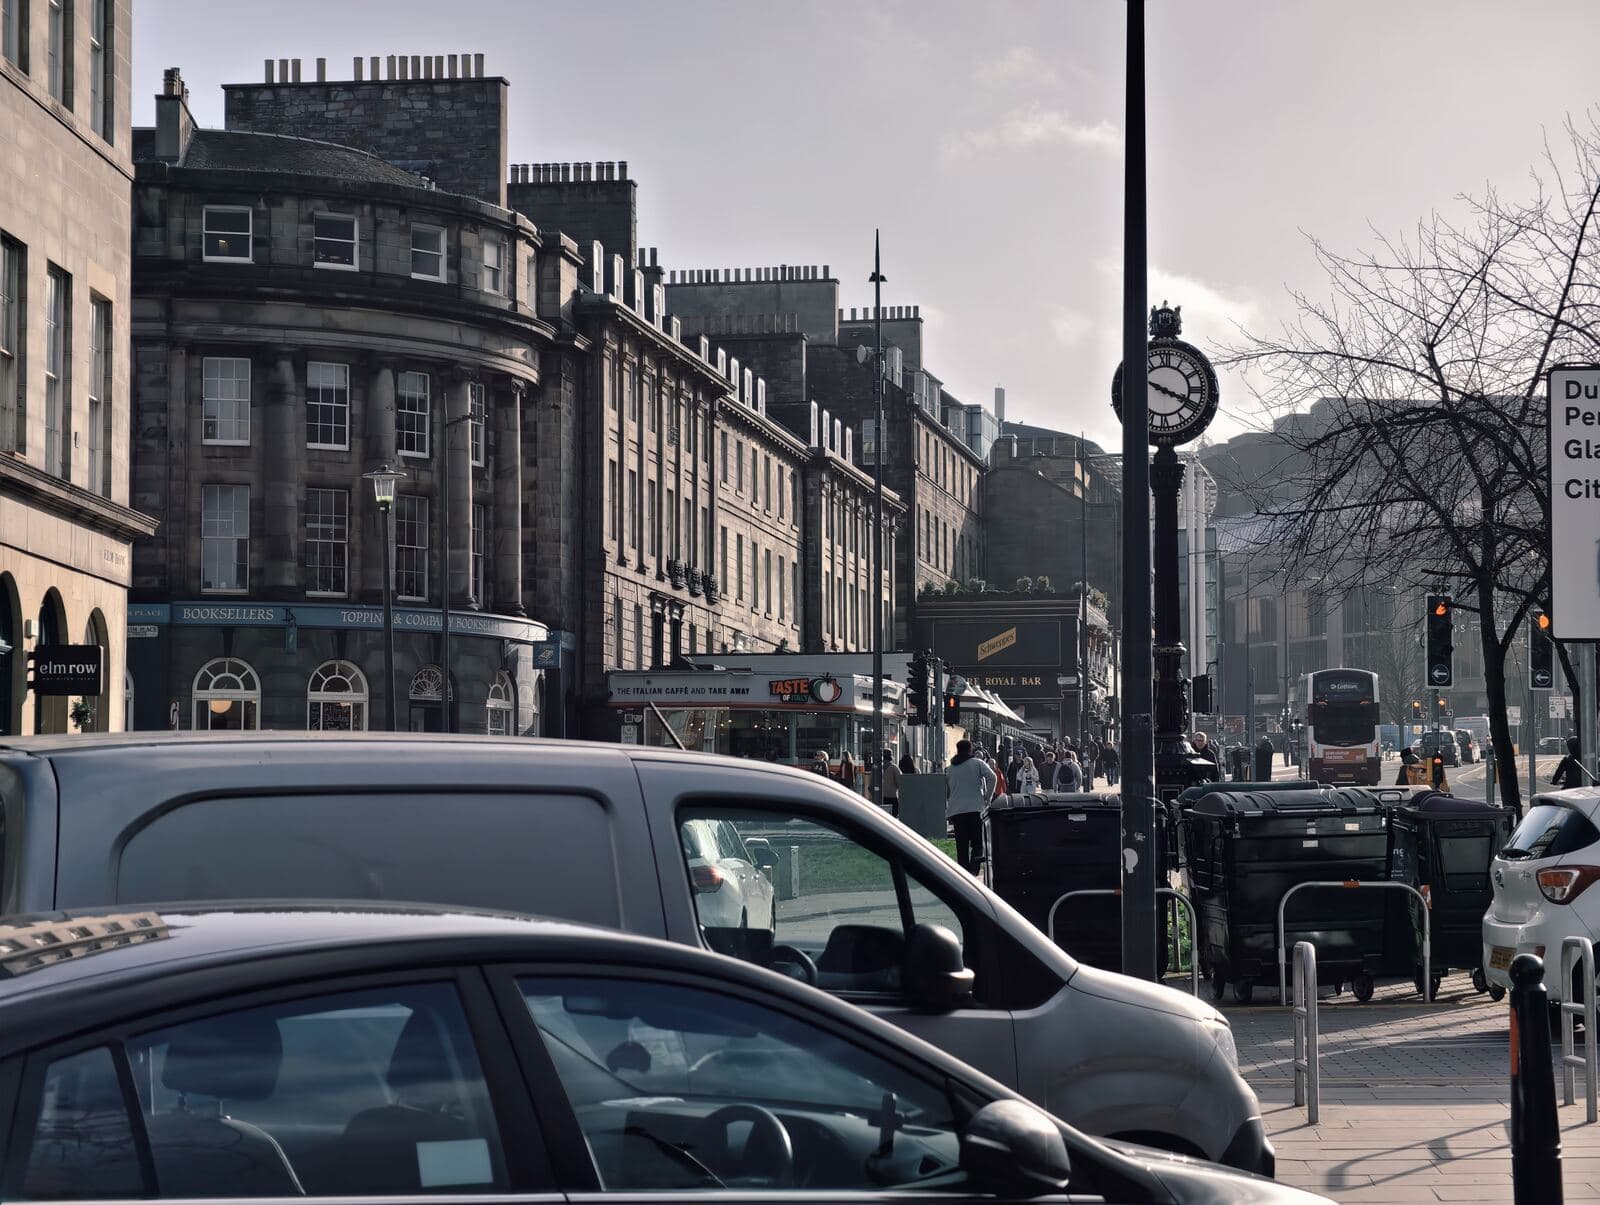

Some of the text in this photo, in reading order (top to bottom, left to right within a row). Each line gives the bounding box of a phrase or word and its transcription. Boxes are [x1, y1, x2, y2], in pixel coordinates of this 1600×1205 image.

[1565, 380, 1598, 399] Du
[1564, 478, 1600, 499] Cit
[183, 607, 274, 620] BOOKSELLERS
[341, 611, 384, 624] TOPPIN
[393, 613, 402, 625] &
[771, 680, 809, 694] TASTE
[985, 677, 1017, 686] ROYAL
[1021, 677, 1042, 686] BAR
[617, 687, 631, 695] THE
[632, 687, 663, 695] ITALIAN
[690, 687, 706, 695] AND
[708, 687, 728, 695] TAKE
[729, 687, 750, 695] AWAY
[782, 694, 791, 702] OF
